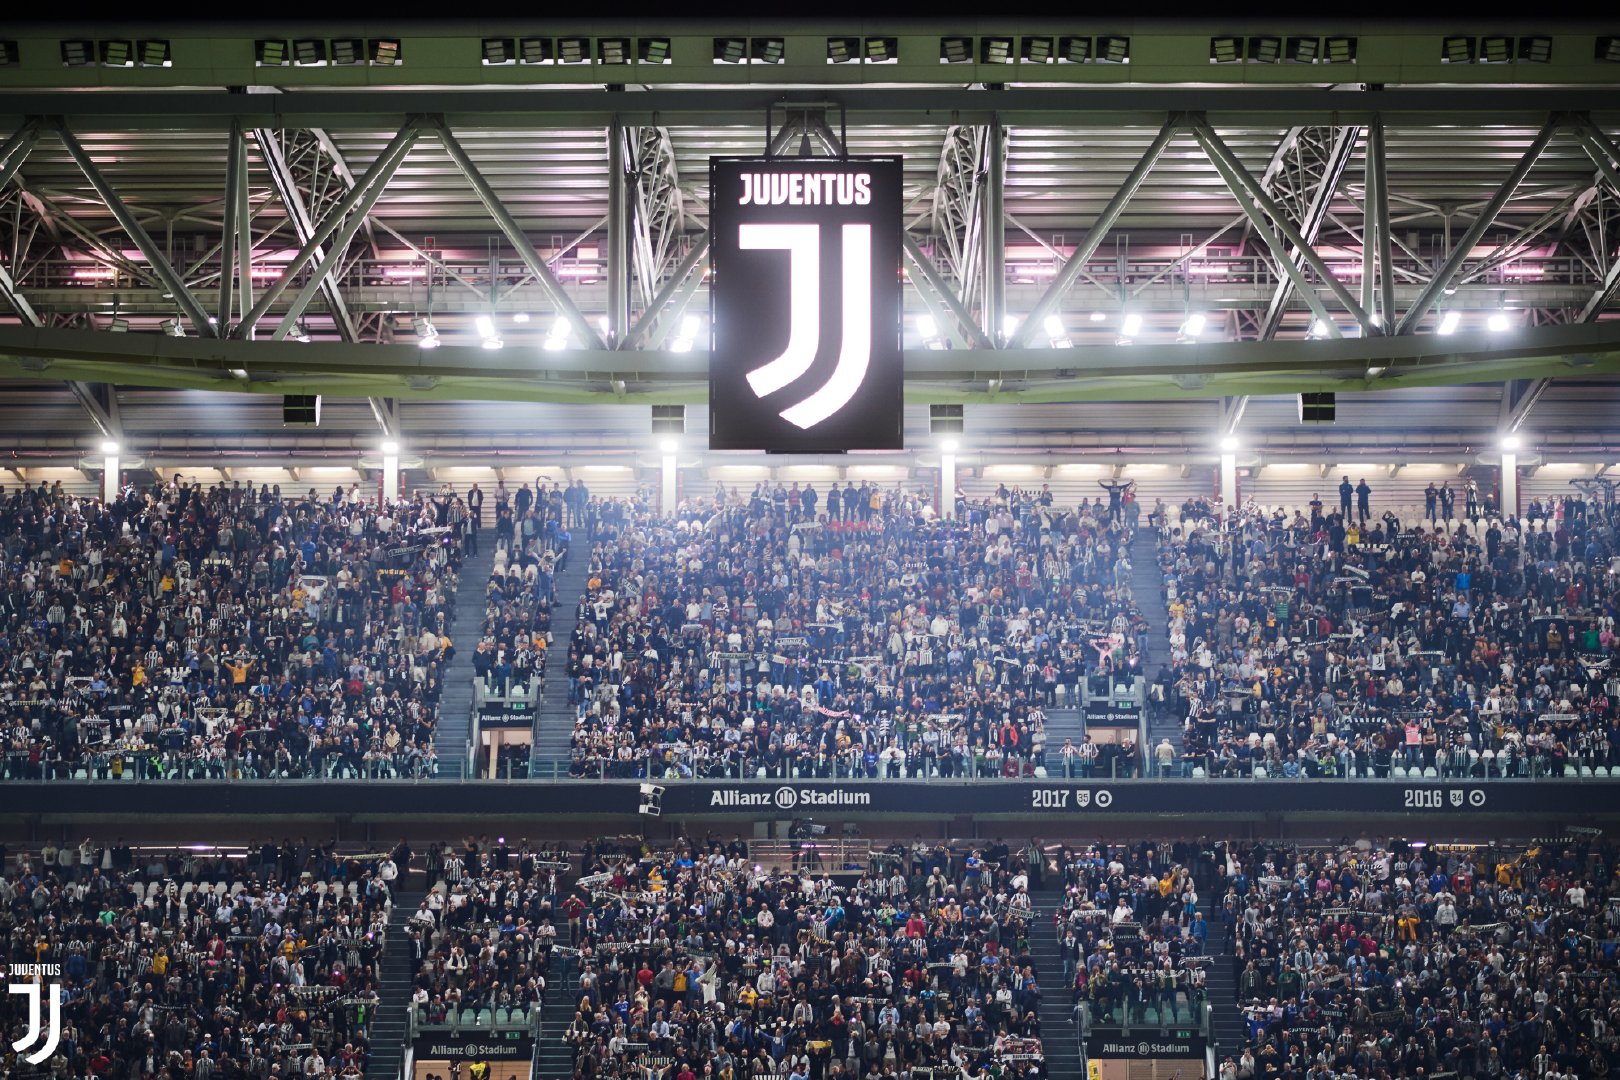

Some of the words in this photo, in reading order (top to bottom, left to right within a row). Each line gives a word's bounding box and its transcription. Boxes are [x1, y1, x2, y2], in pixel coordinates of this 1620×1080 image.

[738, 173, 871, 206] JUVENTUS
[710, 790, 771, 806] Allianz
[800, 789, 871, 805] Stadium
[1032, 789, 1070, 807] 2017
[1404, 789, 1442, 807] 2016
[1451, 793, 1462, 803] 34
[430, 1045, 464, 1055] Allianz
[478, 1045, 517, 1055] Stadium
[1102, 1043, 1136, 1053] Allianz
[1150, 1043, 1190, 1053] Stadium
